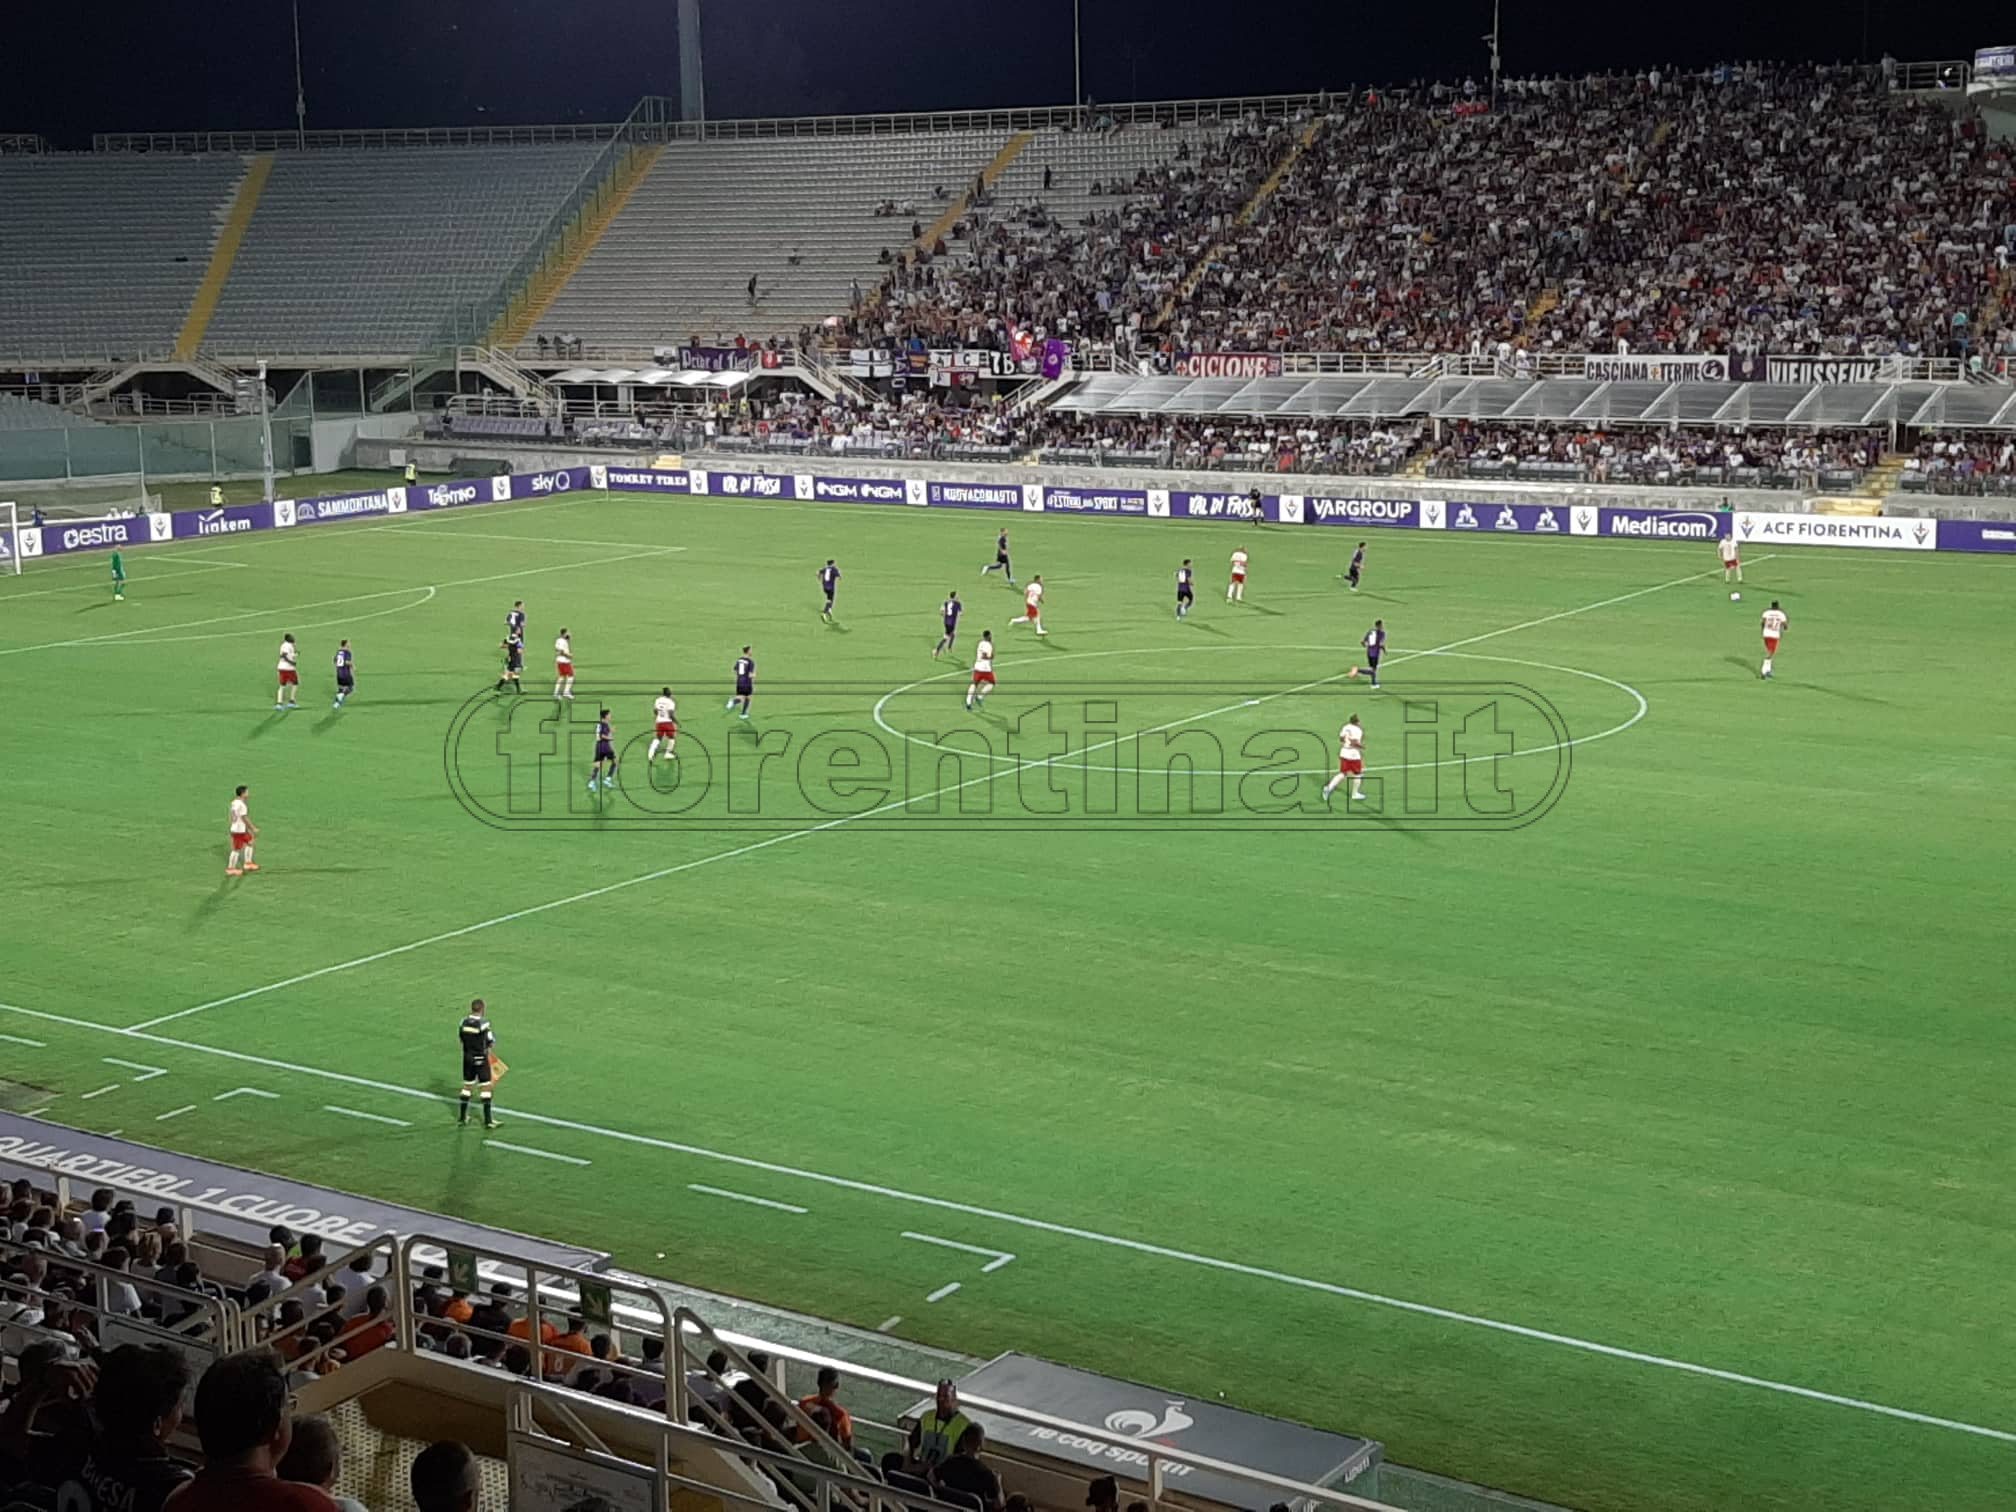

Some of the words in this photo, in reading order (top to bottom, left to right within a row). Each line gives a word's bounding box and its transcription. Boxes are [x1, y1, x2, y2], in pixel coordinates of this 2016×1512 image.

[1587, 361, 1648, 381] CASCIANA
[1660, 362, 1701, 382] TERME
[1312, 498, 1412, 519] VARGROUP
[1612, 514, 1707, 537] Mediacom
[1763, 521, 1795, 535] ACF
[1799, 522, 1903, 540] FIORENTINA
[217, 1194, 378, 1246] CUORE
